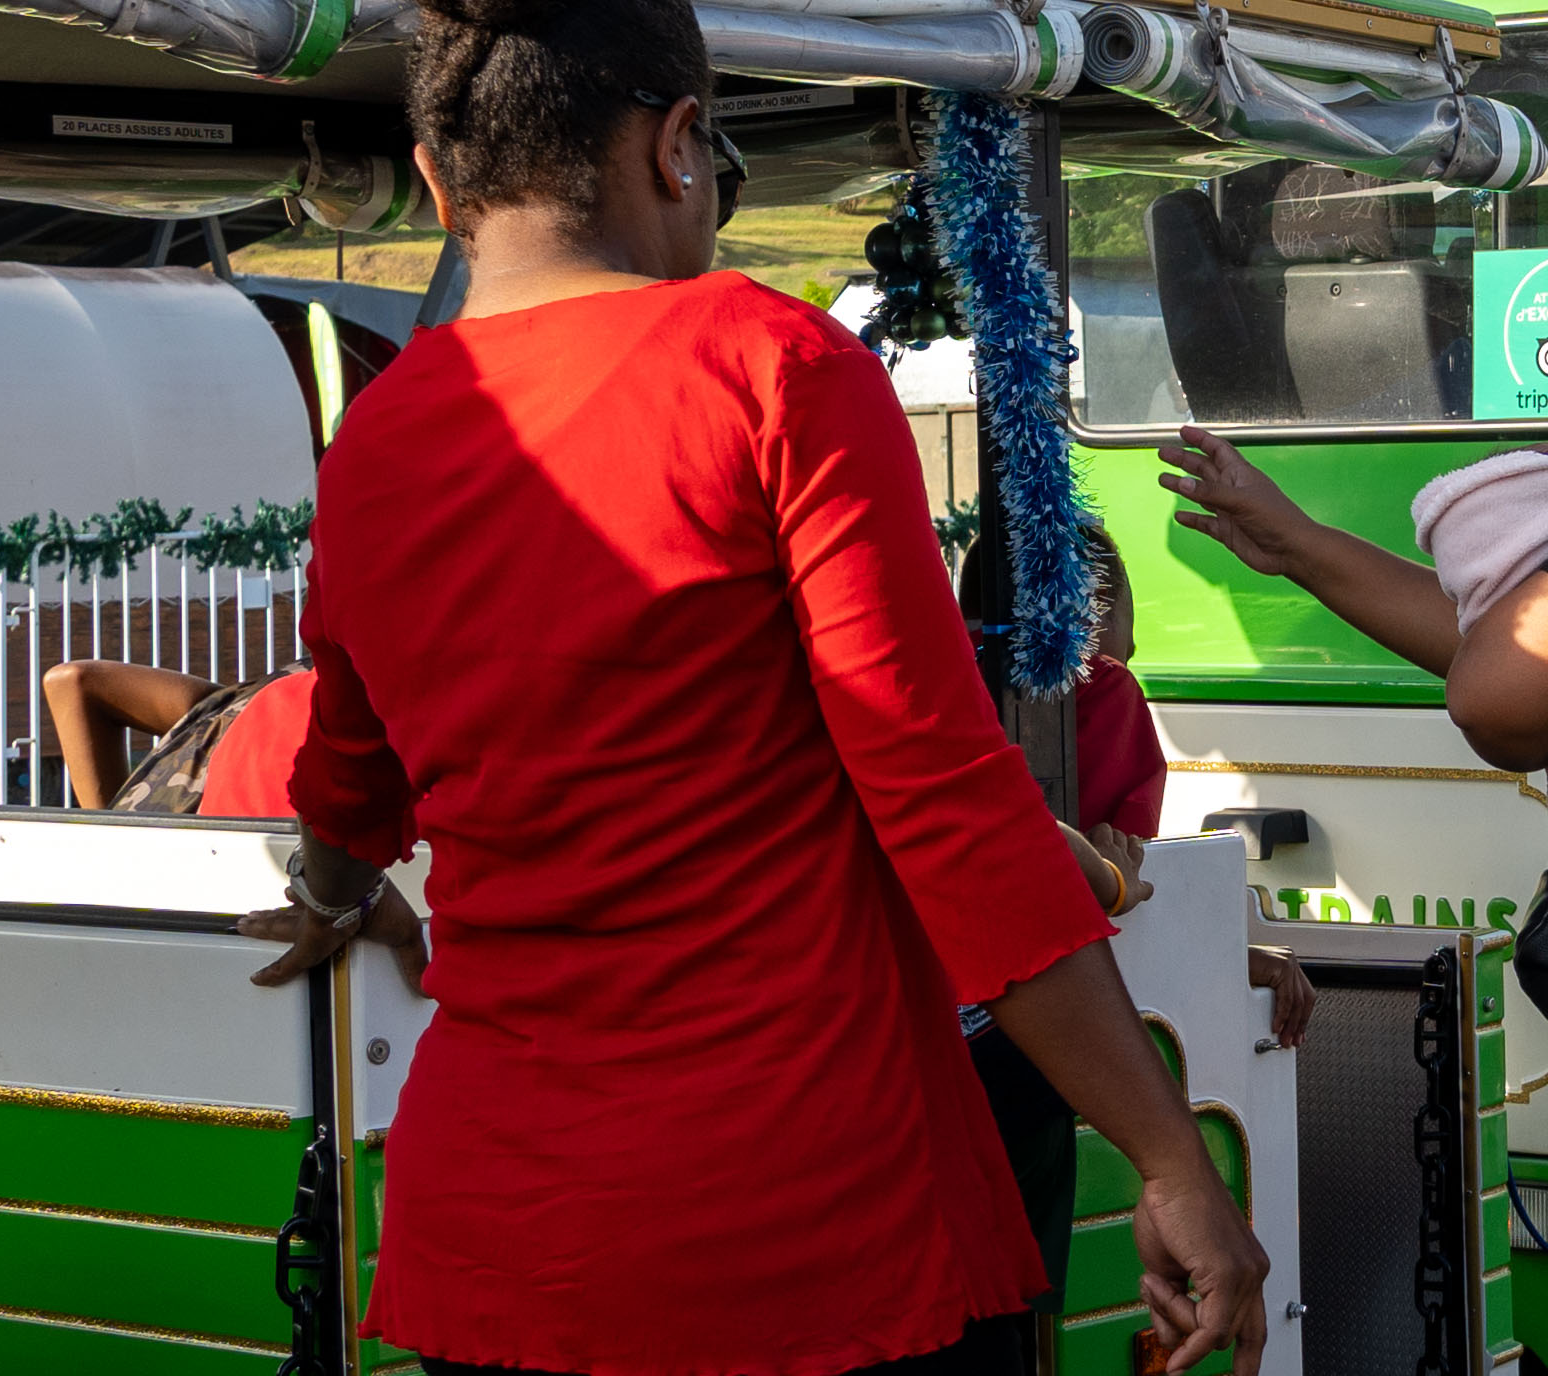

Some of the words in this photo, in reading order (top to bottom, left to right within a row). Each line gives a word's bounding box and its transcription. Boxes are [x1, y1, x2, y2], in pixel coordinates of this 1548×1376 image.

[62, 121, 75, 131] 20
[78, 121, 122, 134] PLACES
[125, 124, 172, 137] ASSISES
[175, 127, 225, 139] ADULTES
